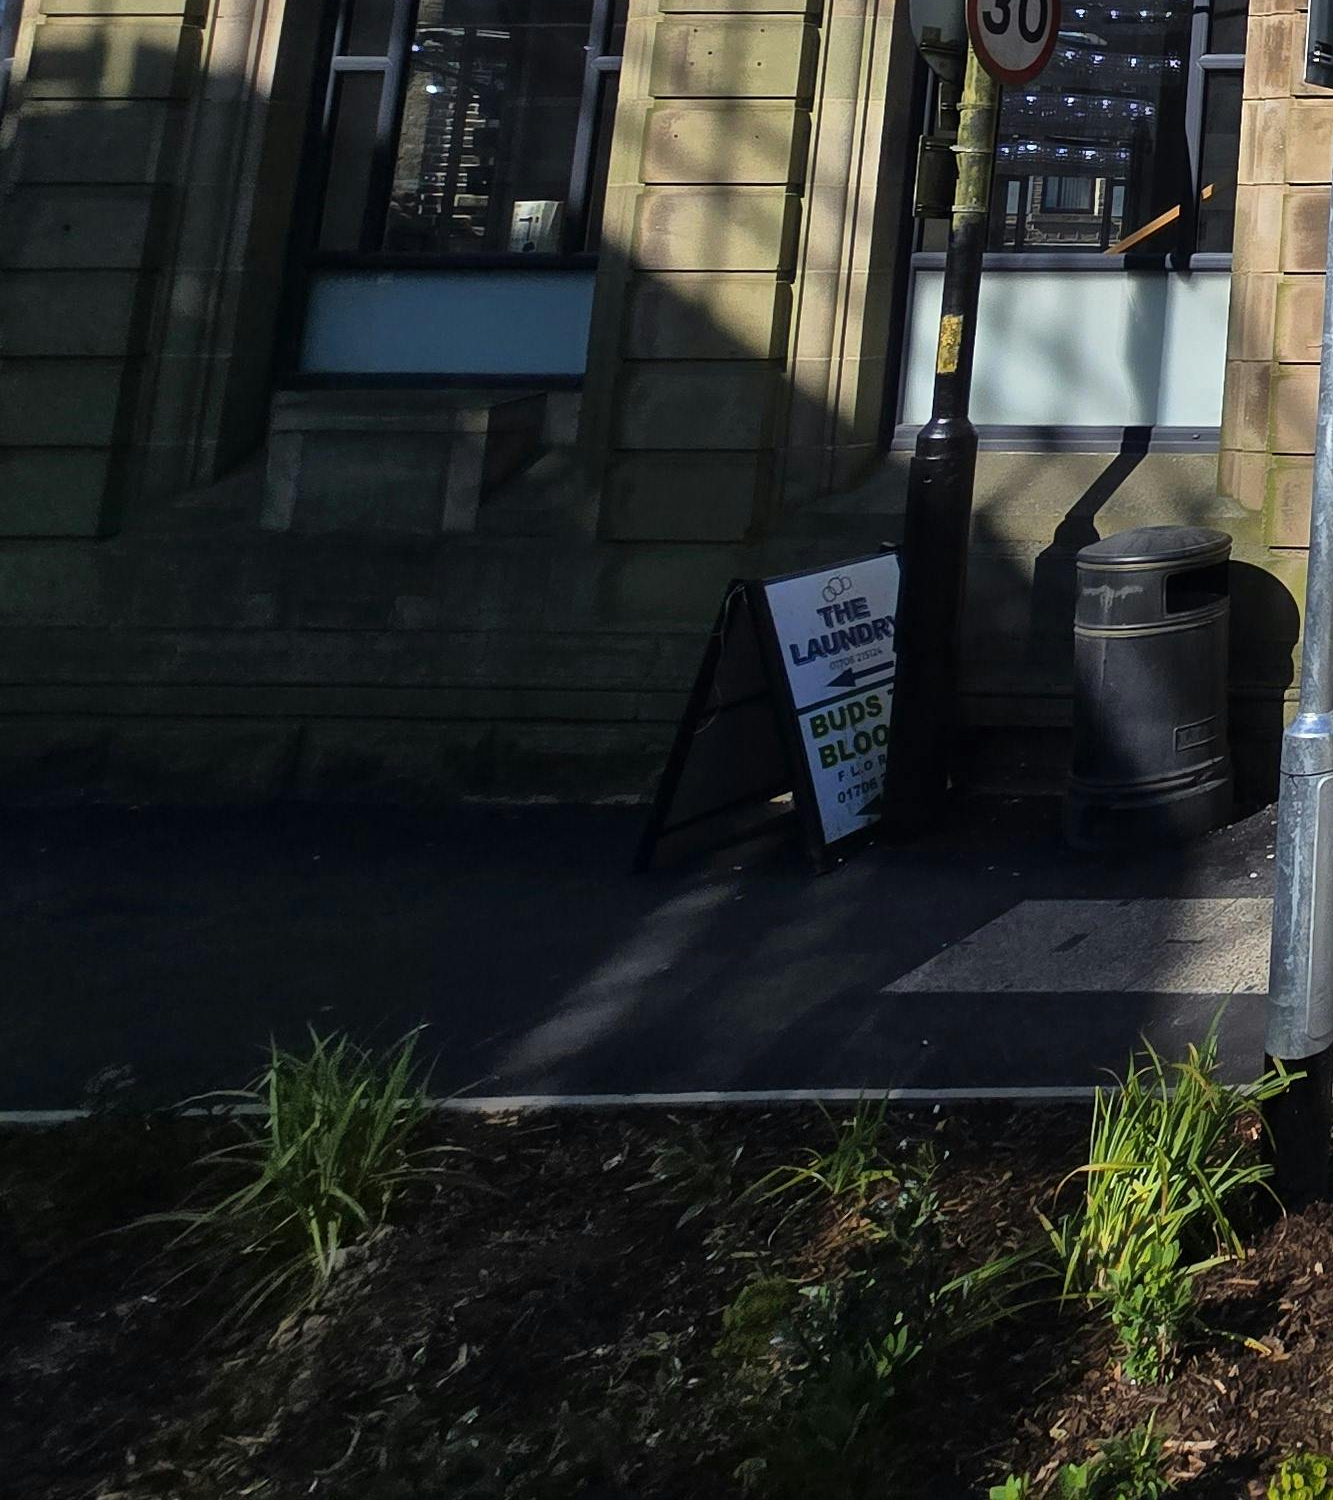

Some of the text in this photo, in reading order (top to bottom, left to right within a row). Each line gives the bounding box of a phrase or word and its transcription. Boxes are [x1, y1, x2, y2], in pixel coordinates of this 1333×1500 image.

[816, 596, 871, 629] THE
[809, 694, 883, 740] BUDS
[817, 723, 890, 770] BLOO
